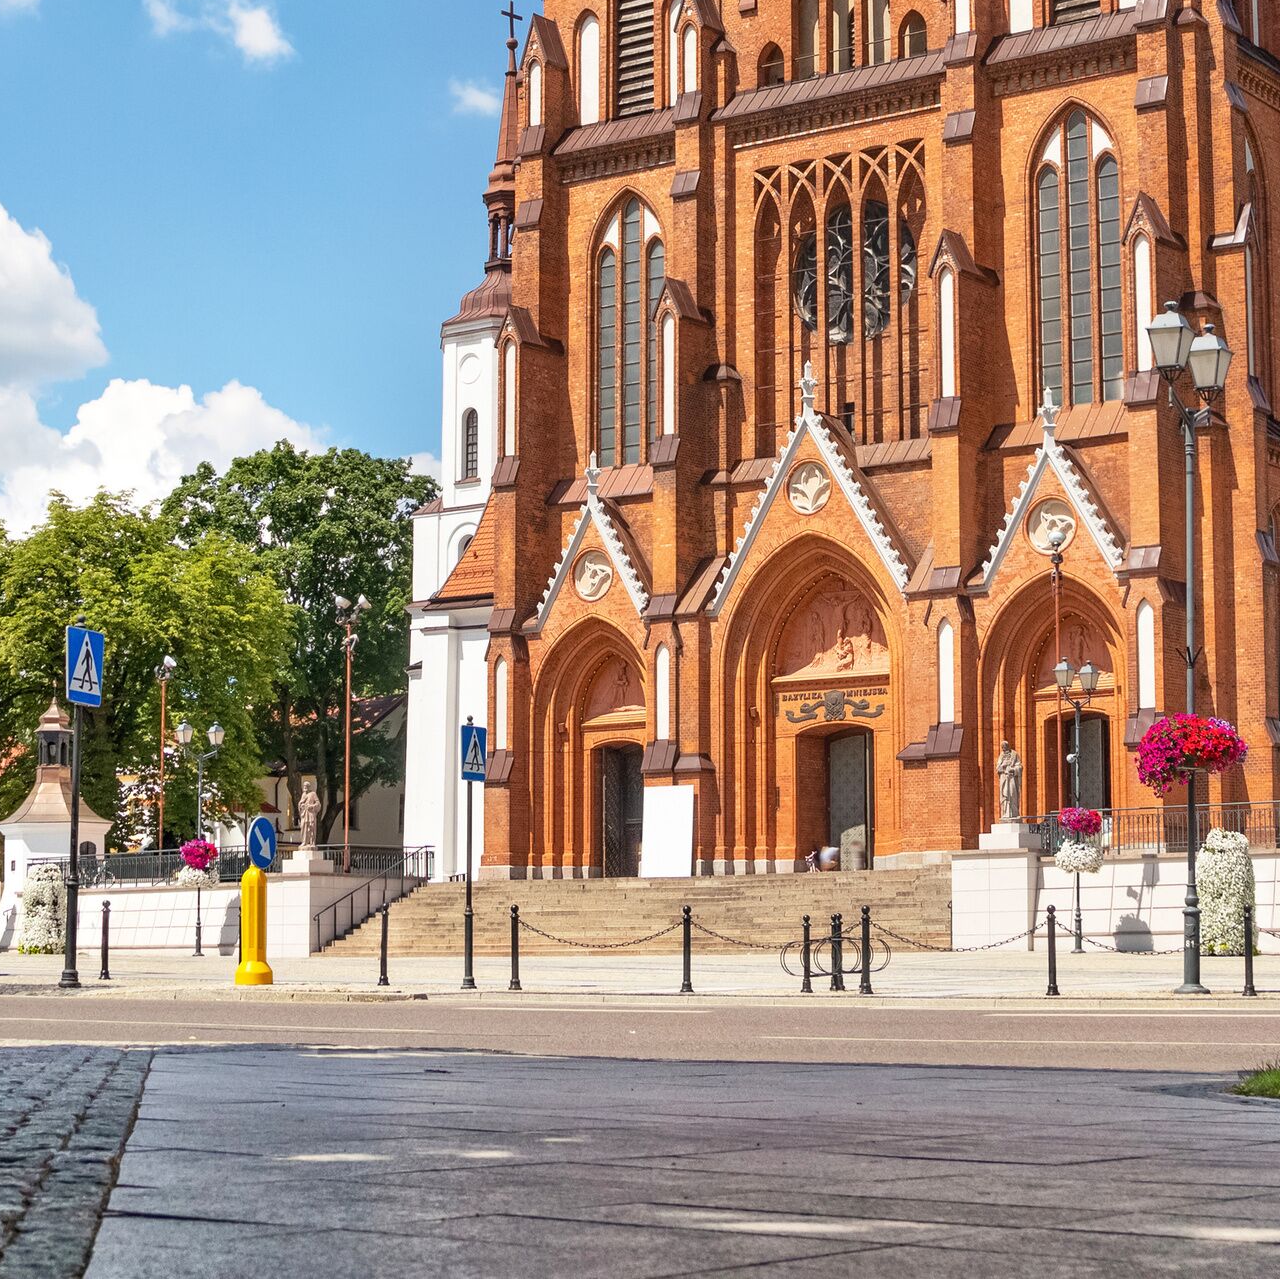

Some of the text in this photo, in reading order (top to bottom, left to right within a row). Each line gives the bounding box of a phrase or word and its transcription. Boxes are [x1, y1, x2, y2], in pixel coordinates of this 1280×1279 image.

[782, 688, 888, 702] BAZYLIKA MNIEJSZA
[1185, 939, 1195, 948] 81
